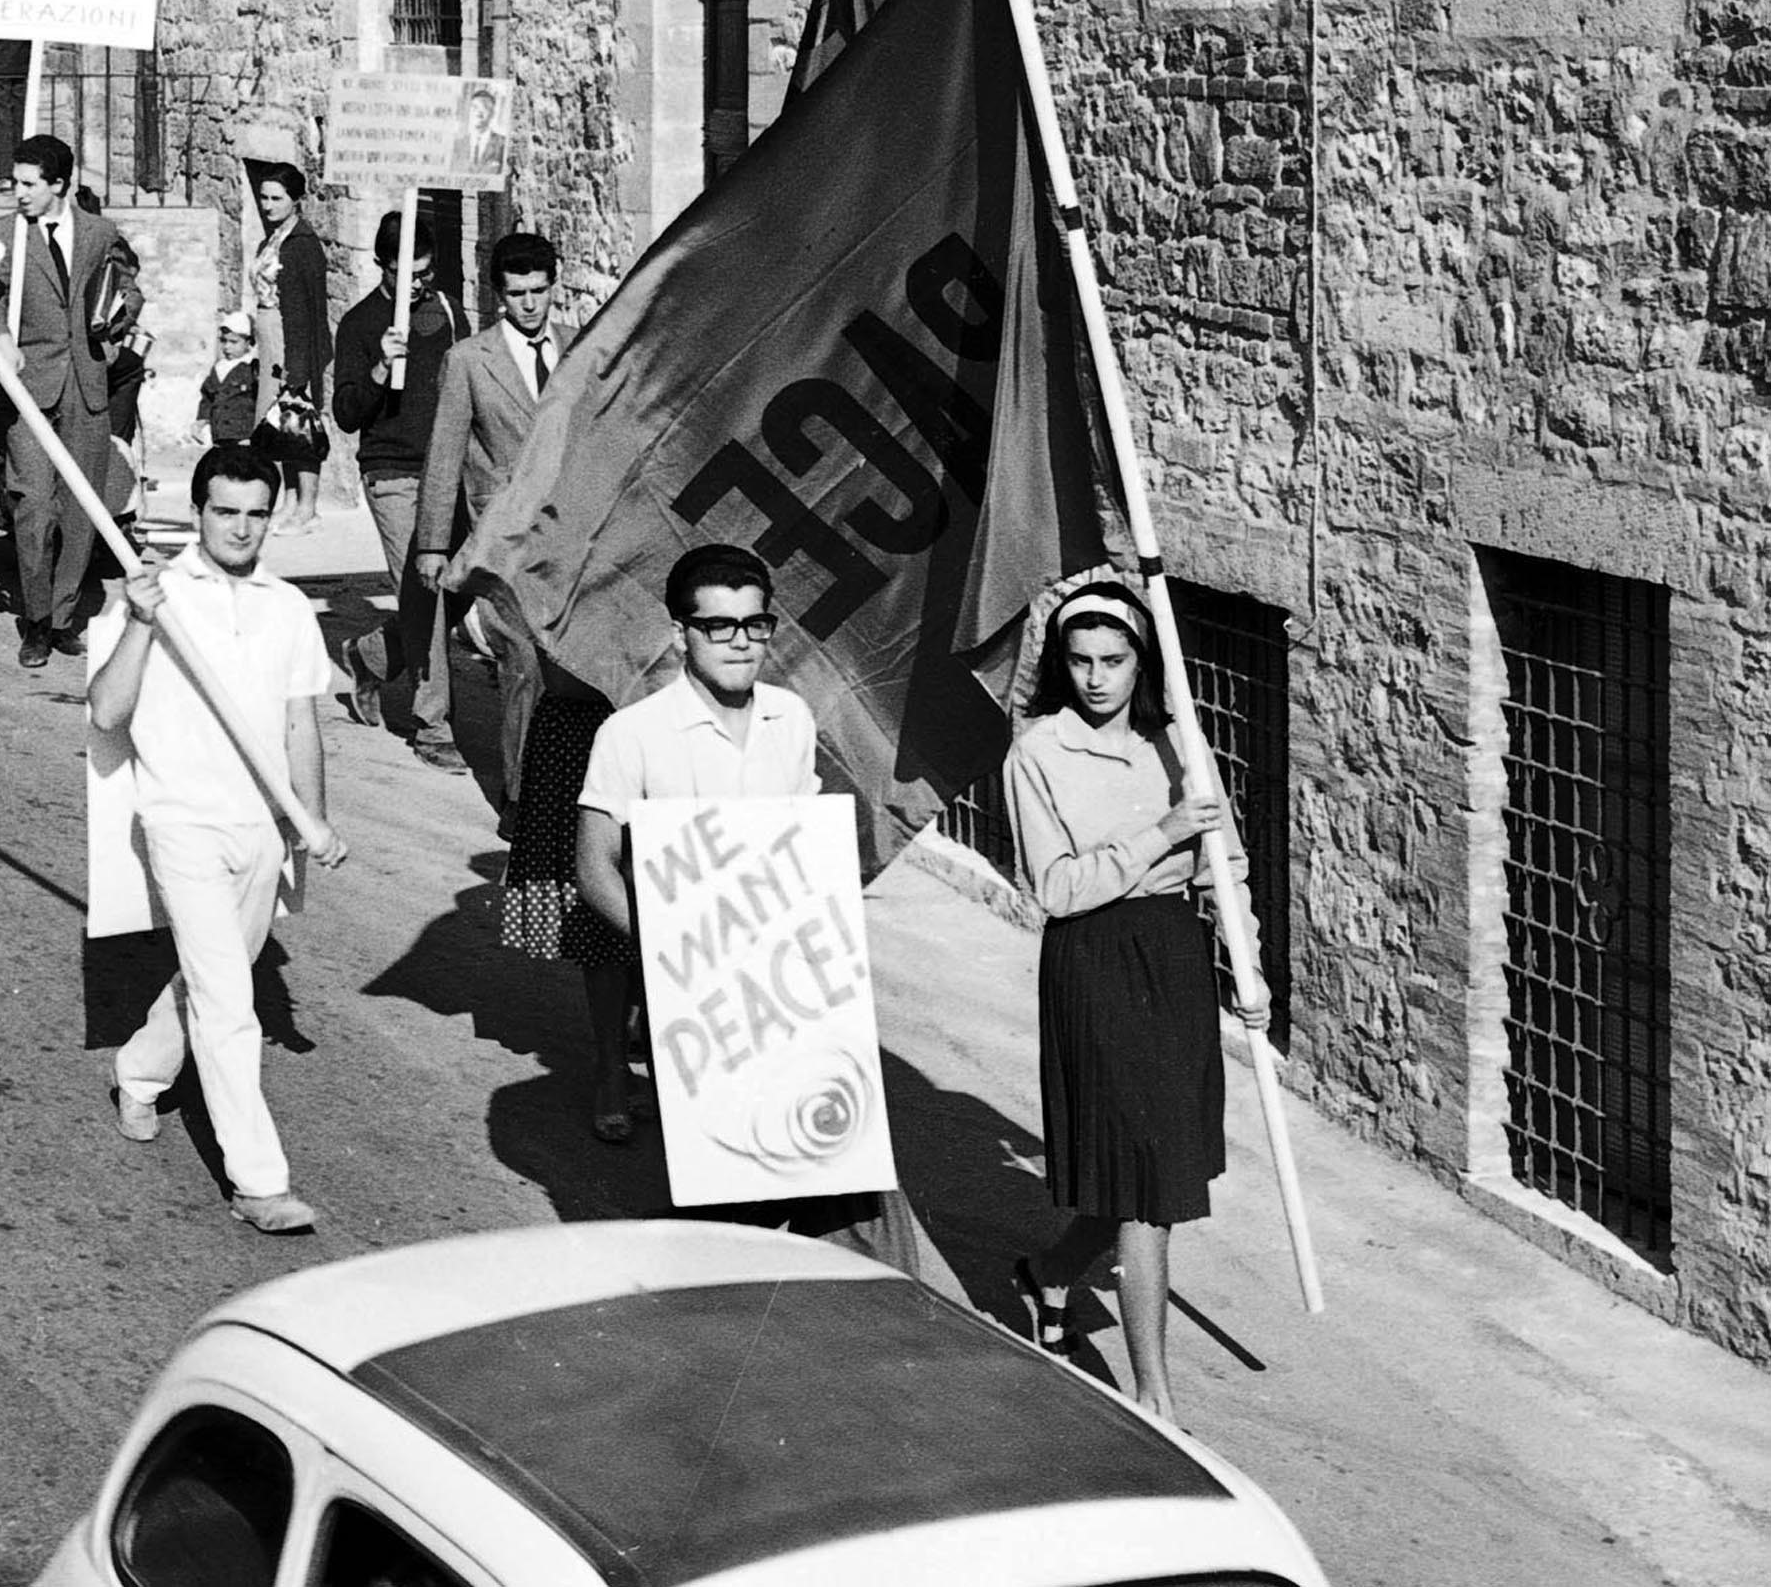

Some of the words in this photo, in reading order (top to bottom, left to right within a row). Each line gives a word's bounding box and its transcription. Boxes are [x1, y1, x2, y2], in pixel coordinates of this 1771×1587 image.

[644, 805, 746, 904] WE
[657, 823, 816, 993] WANT
[659, 893, 866, 1099] PEACE!
